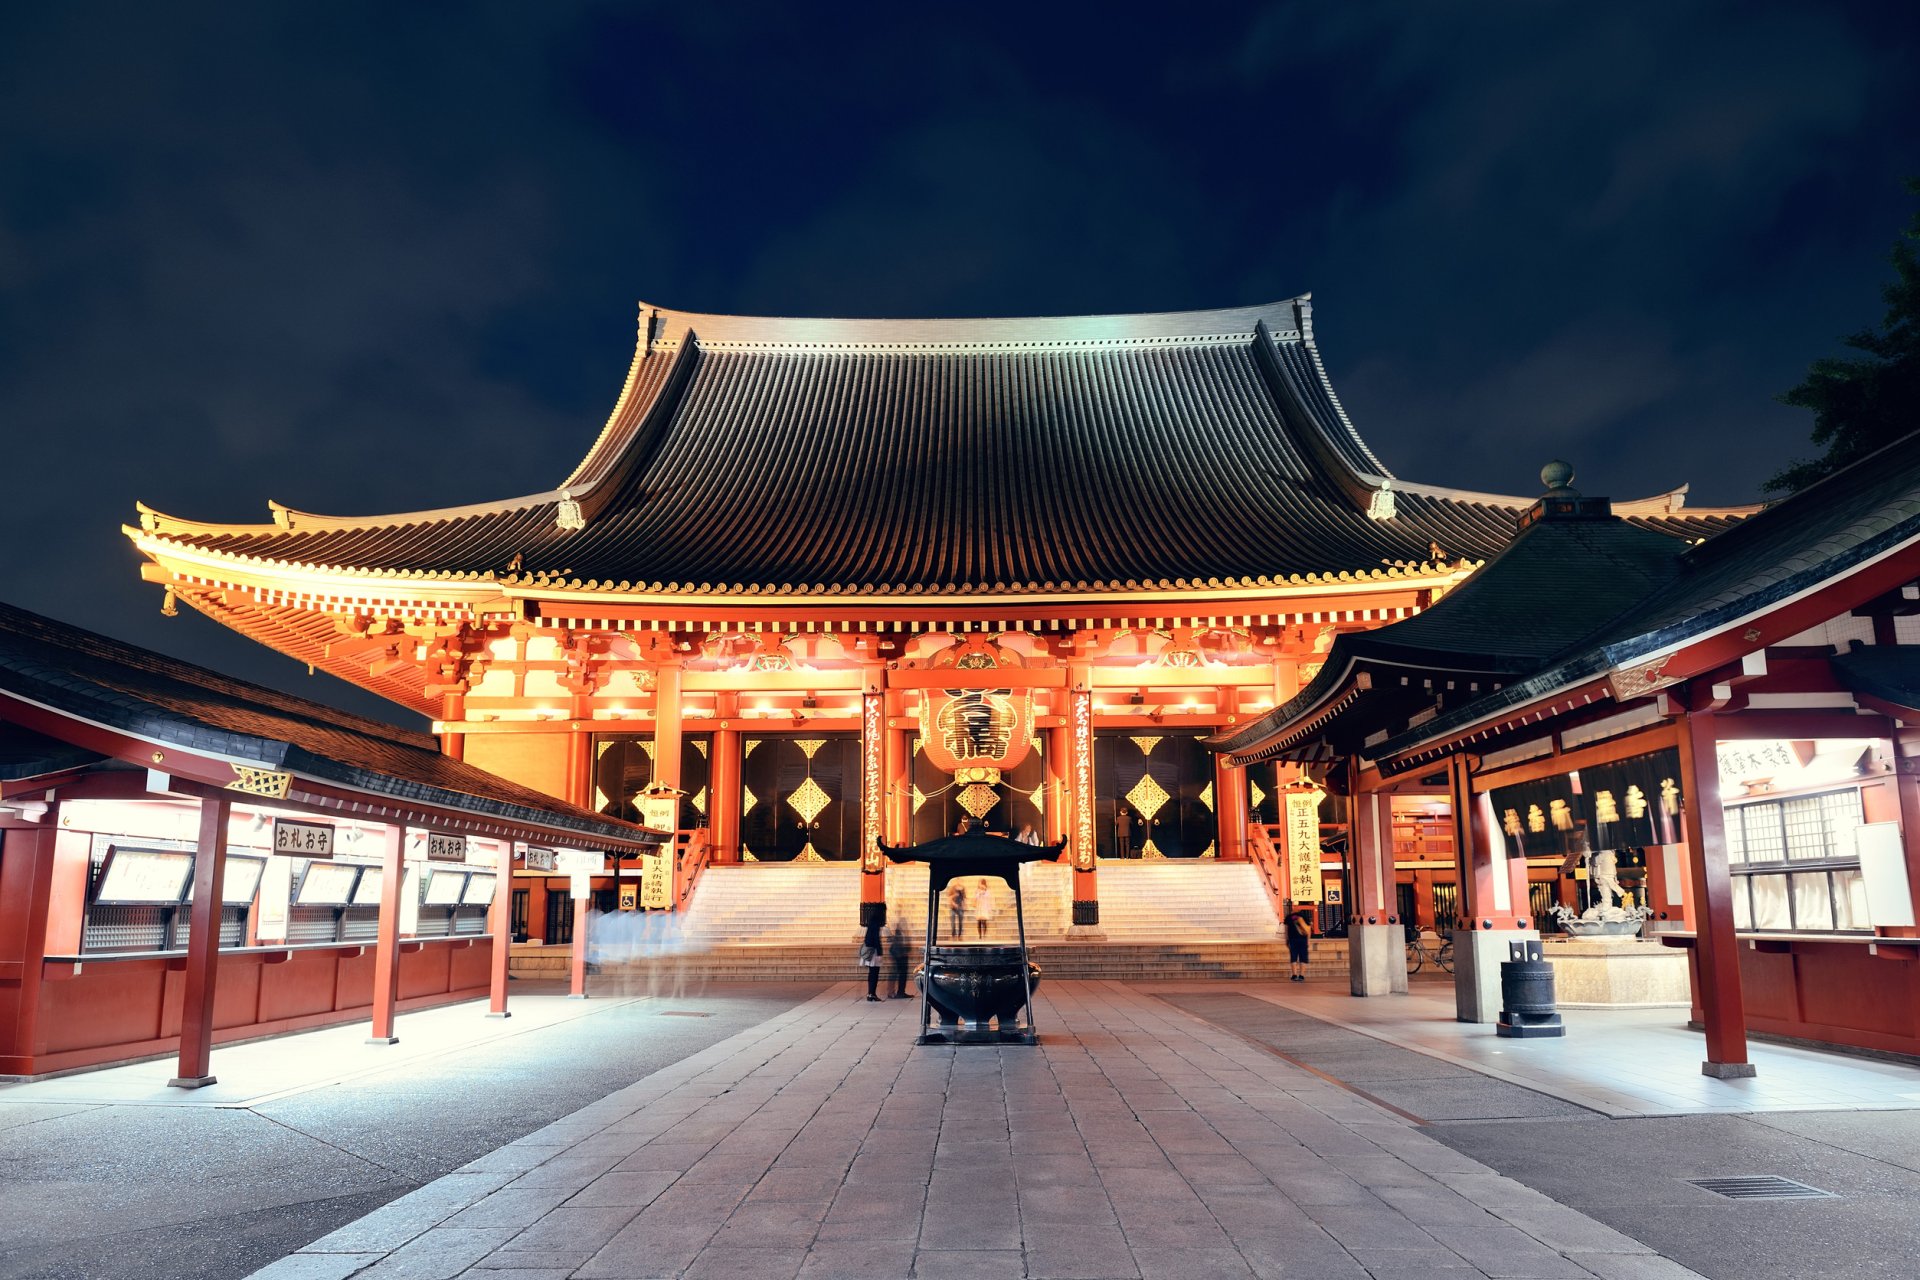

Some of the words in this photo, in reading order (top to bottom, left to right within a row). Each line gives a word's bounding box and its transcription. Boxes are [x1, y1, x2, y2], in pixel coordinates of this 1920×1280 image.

[277, 827, 328, 851] お札お守
[430, 837, 462, 857] お札お守
[1297, 808, 1313, 896] 正五九大護摩執行
